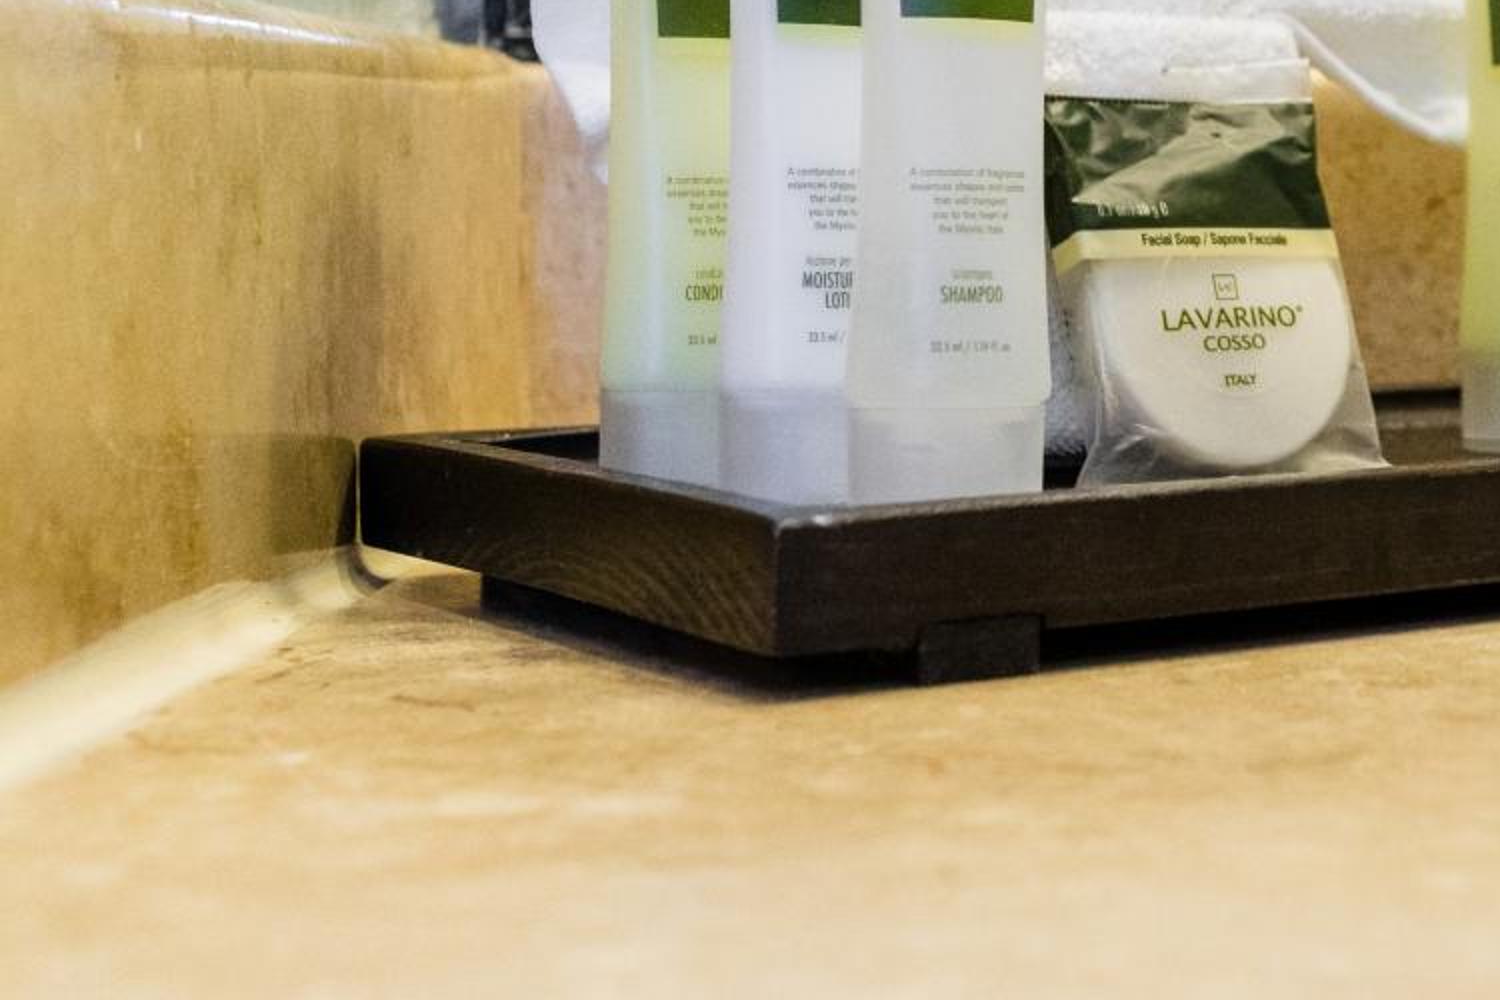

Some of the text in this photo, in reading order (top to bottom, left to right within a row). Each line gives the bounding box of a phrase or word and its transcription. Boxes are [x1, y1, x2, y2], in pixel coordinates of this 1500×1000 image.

[1141, 233, 1172, 247] Facial
[1174, 233, 1200, 248] Soap
[1210, 232, 1247, 247] Sapone
[940, 284, 1004, 304] SHAMPOO
[1160, 304, 1303, 332] LAVARINO
[1202, 333, 1267, 353] COSSO
[1224, 373, 1257, 388] ITALY
